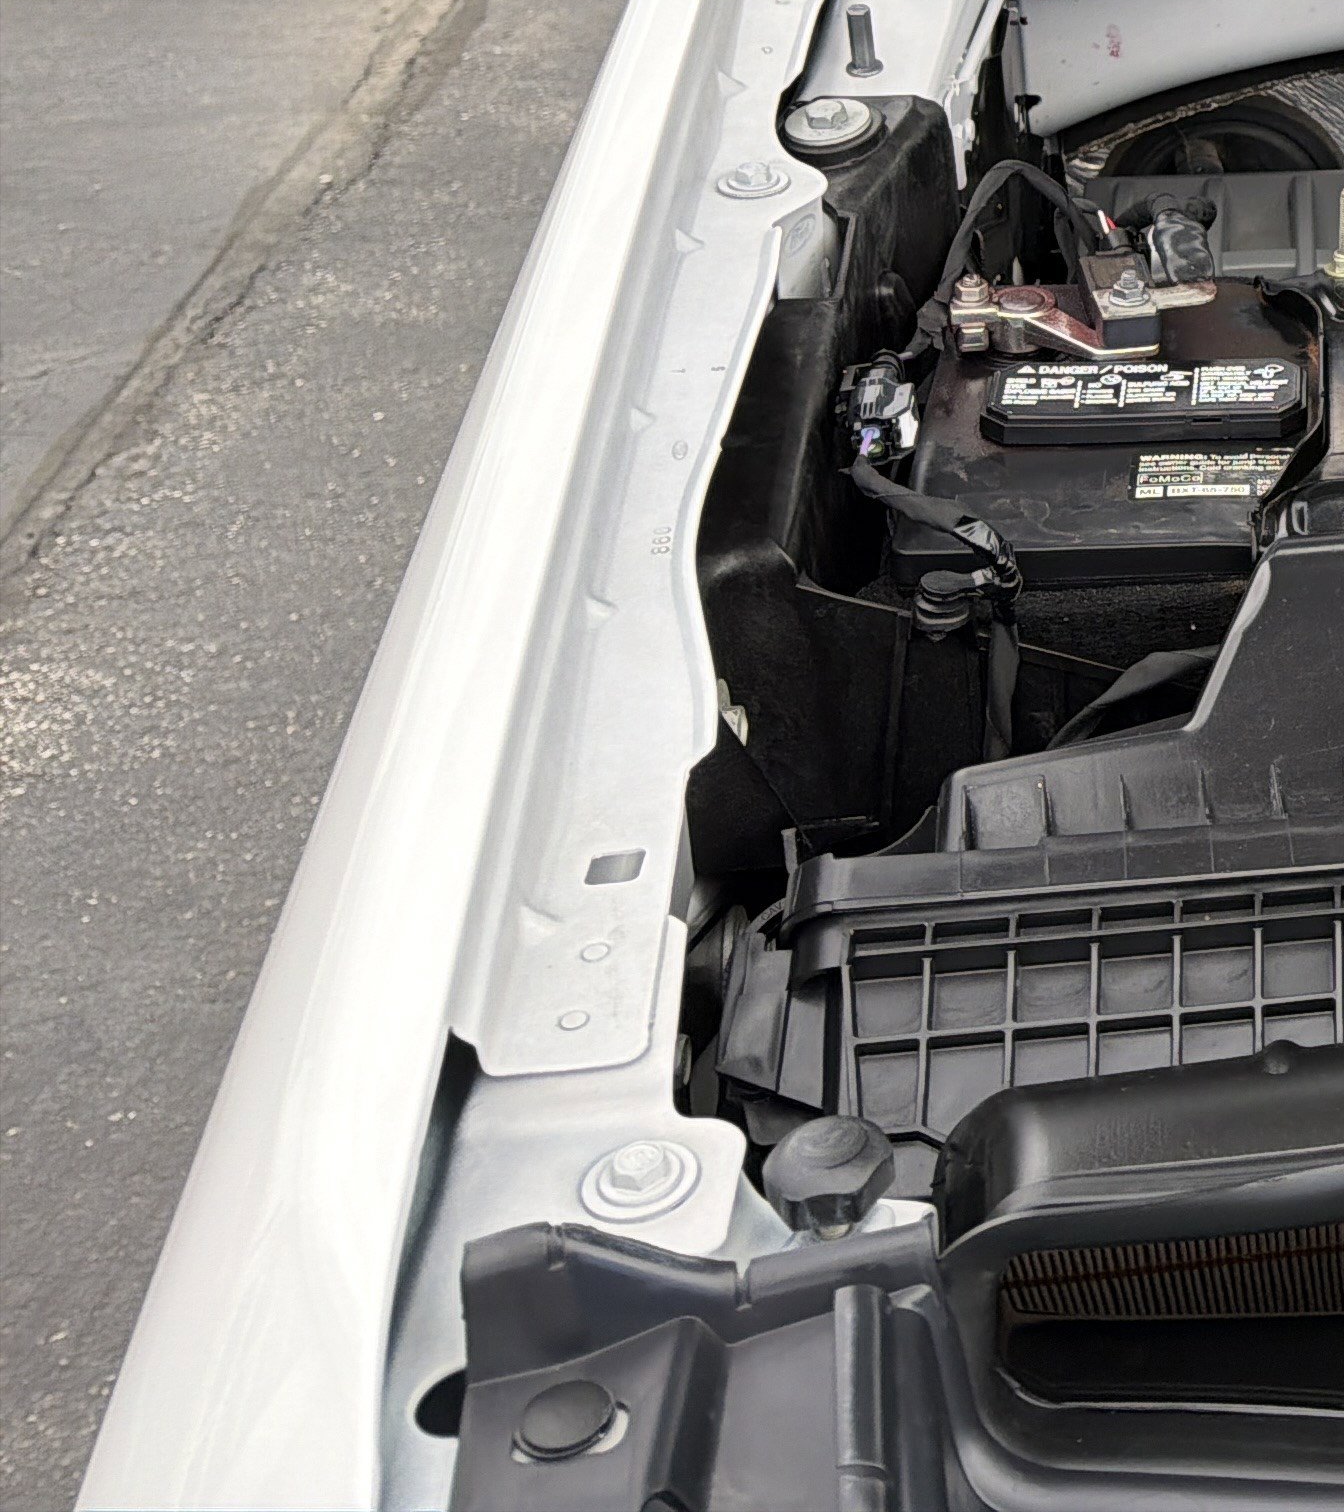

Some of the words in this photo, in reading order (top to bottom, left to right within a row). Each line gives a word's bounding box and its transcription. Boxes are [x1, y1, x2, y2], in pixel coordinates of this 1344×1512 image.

[1038, 365, 1098, 374] DANGER
[1114, 364, 1168, 373] POISON
[1140, 475, 1201, 483] FoMoCo
